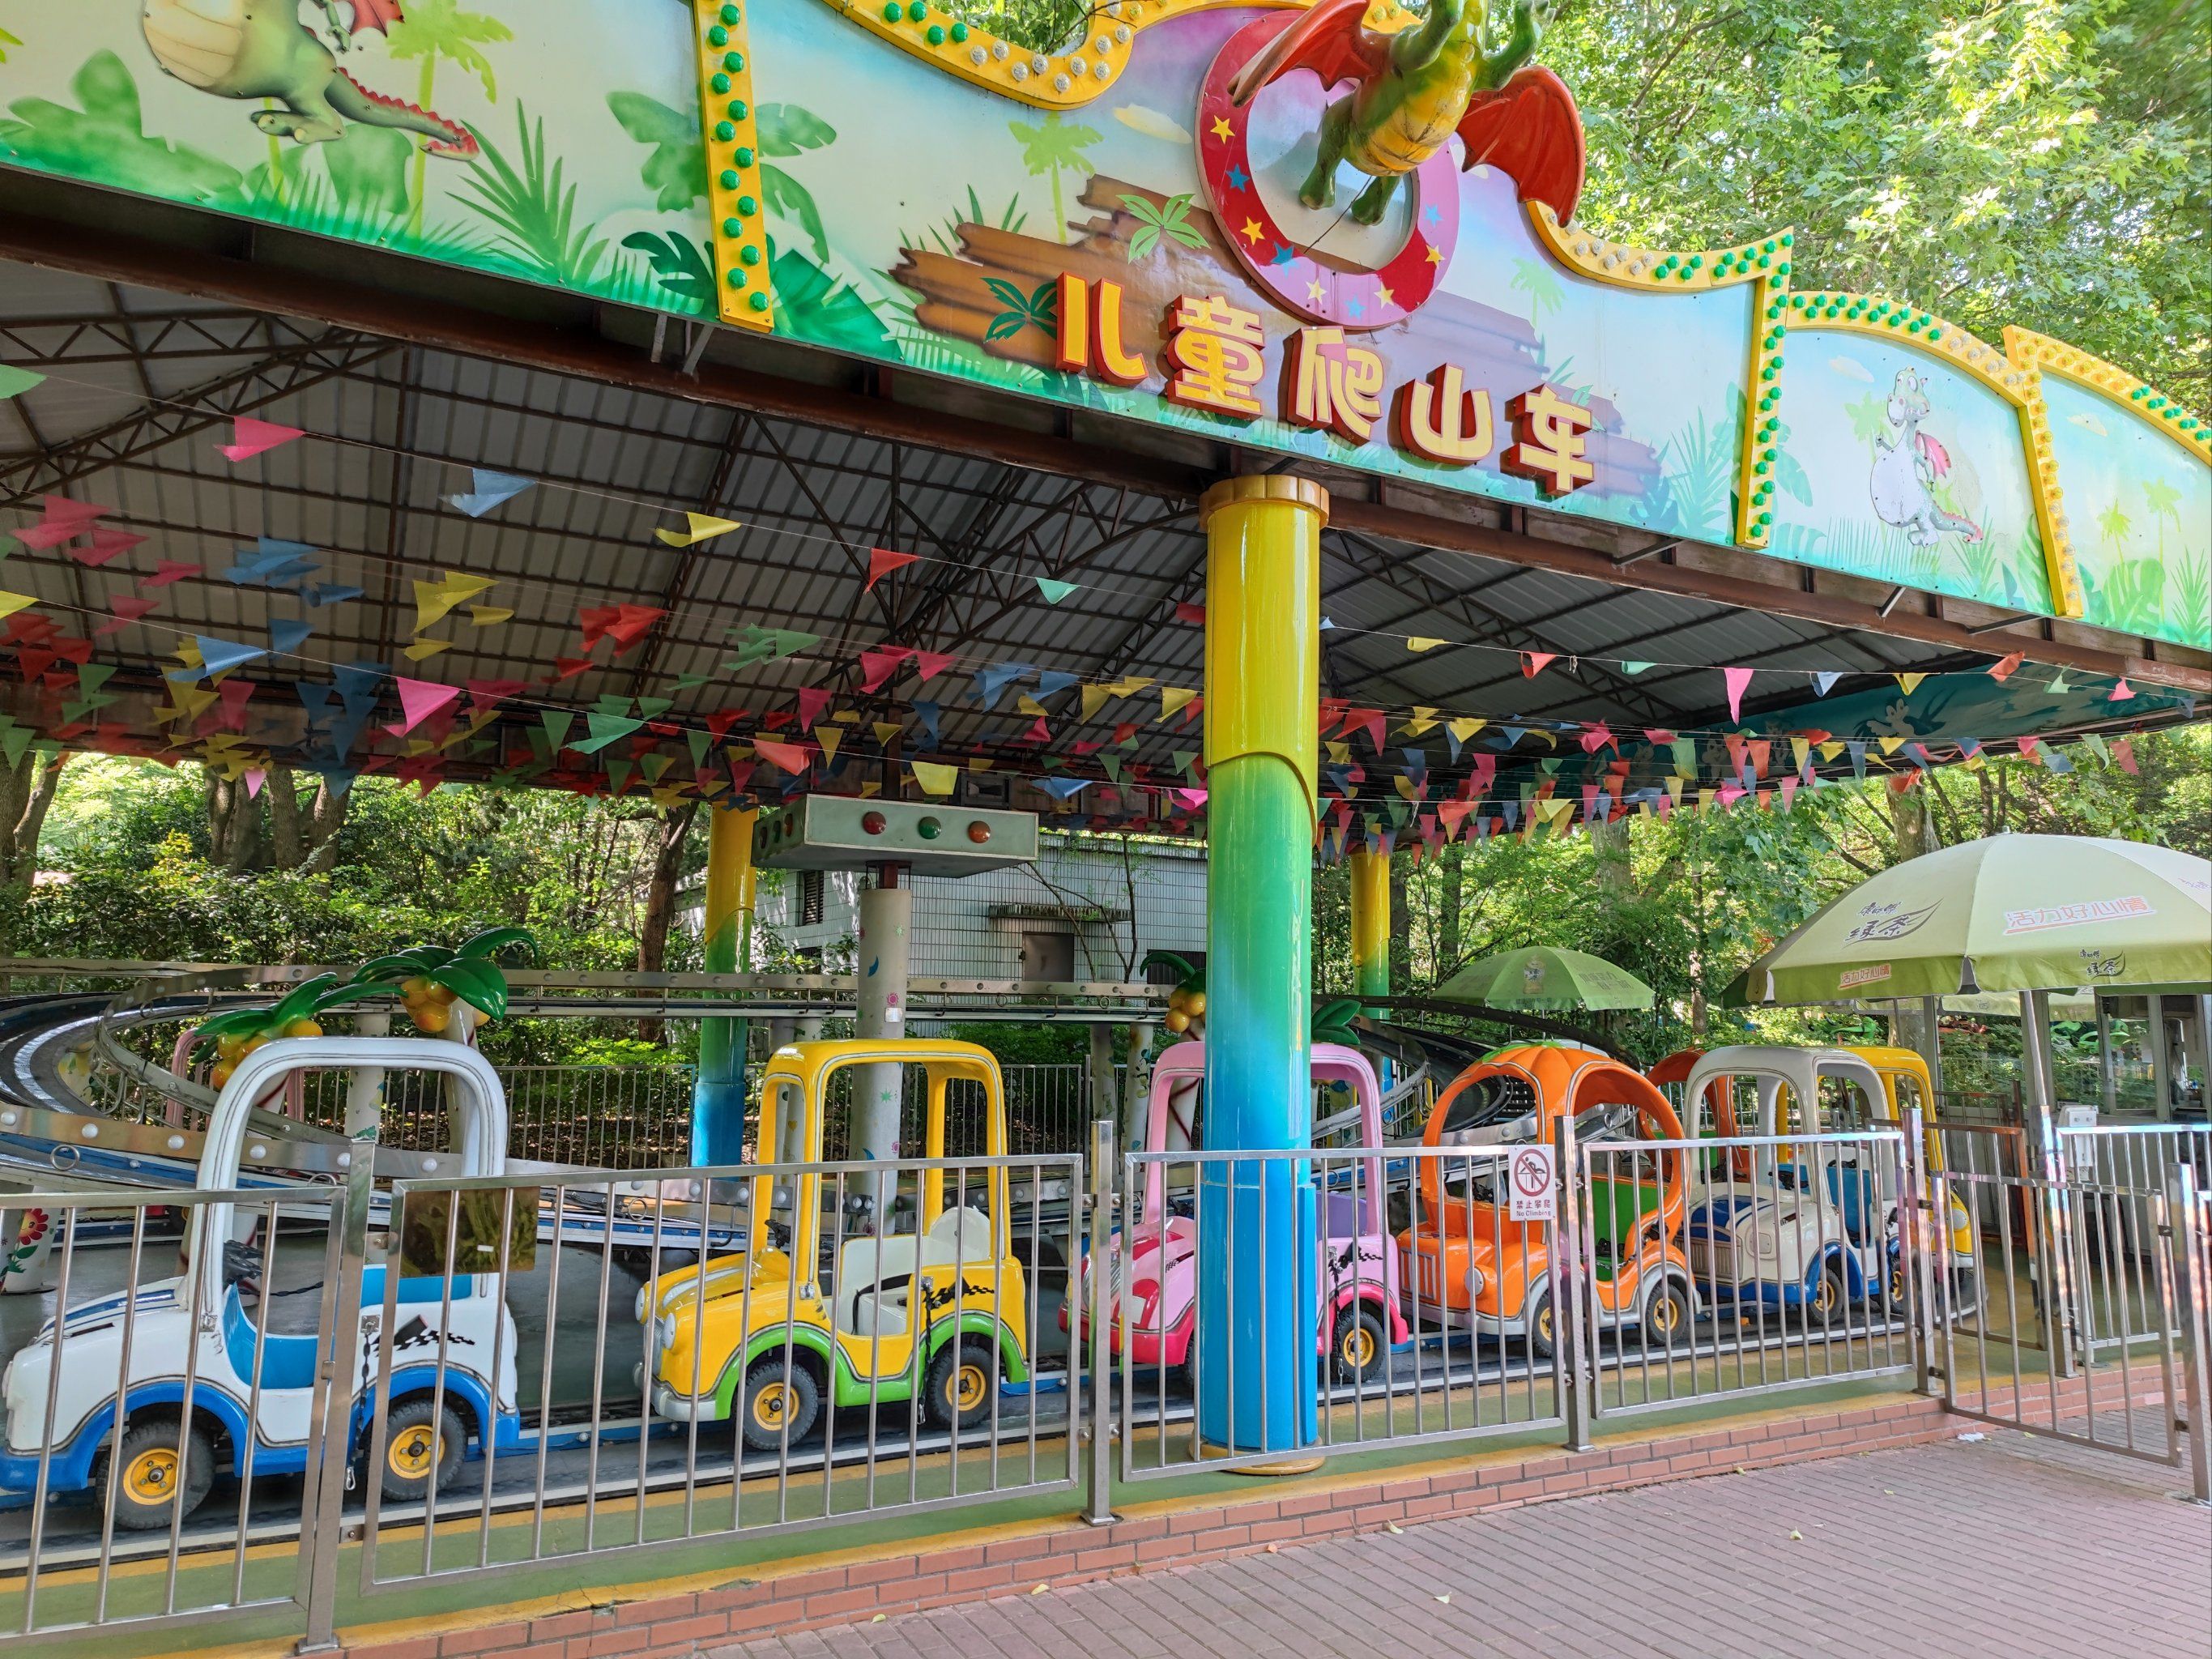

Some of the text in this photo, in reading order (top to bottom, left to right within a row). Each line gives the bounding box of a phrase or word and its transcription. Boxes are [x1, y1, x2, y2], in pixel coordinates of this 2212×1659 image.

[1056, 271, 1594, 494] 儿童爬山车
[2008, 897, 2148, 928] 活力好心情
[1845, 915, 1909, 940] 绿茶
[1842, 964, 1890, 984] 活力好心情
[1516, 1200, 1551, 1209] 禁止攀爬
